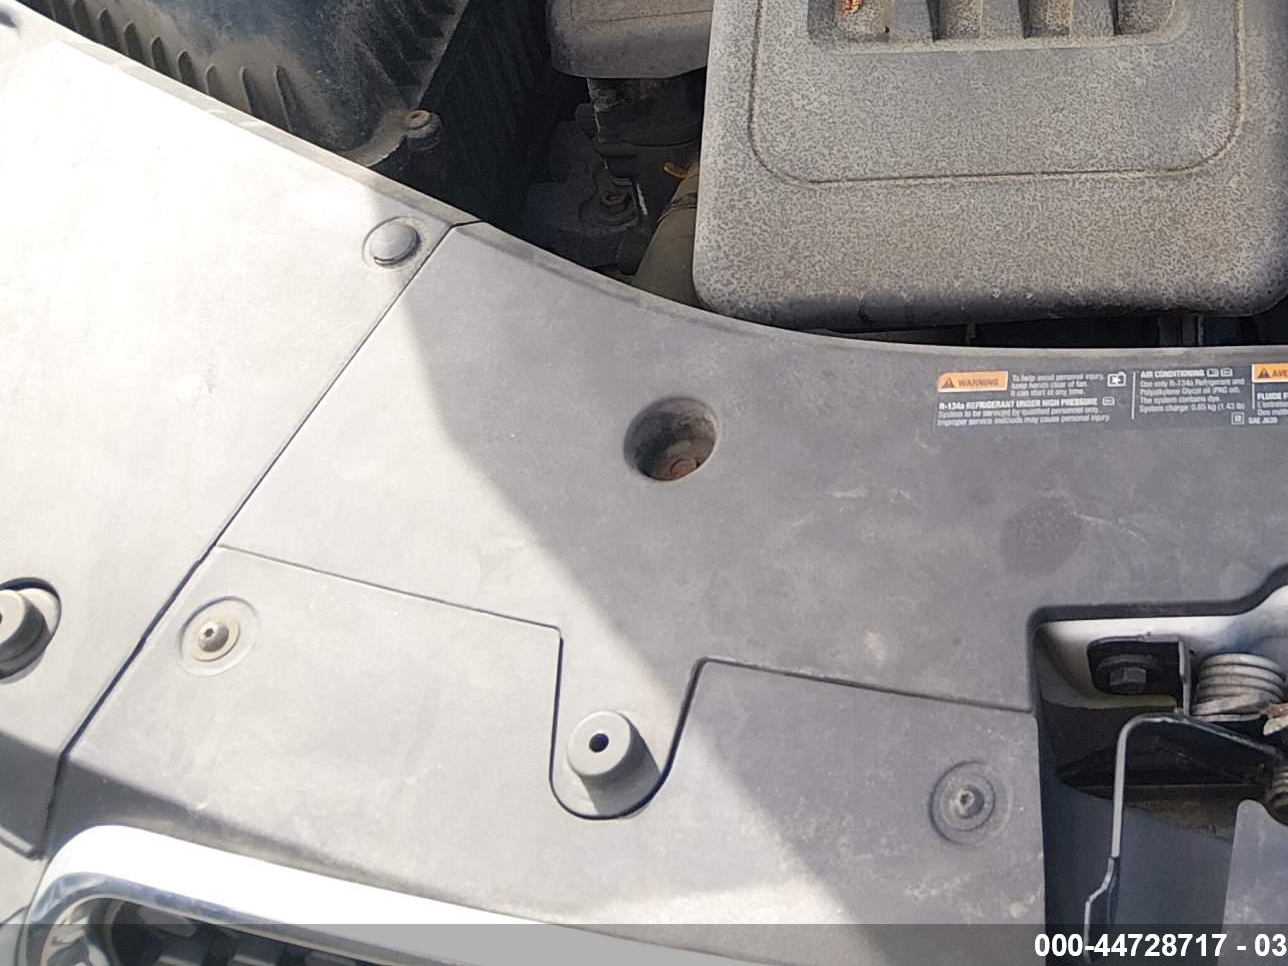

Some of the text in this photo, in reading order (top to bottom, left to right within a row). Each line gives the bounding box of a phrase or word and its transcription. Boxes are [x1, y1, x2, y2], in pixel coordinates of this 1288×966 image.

[1140, 369, 1205, 378] AIR CONDITIONING
[958, 377, 1000, 387] WARNING
[1257, 392, 1282, 401] FLUIDE
[939, 397, 1098, 411] R-134a REFRIGERANT UNDER HIGH PRESSURE
